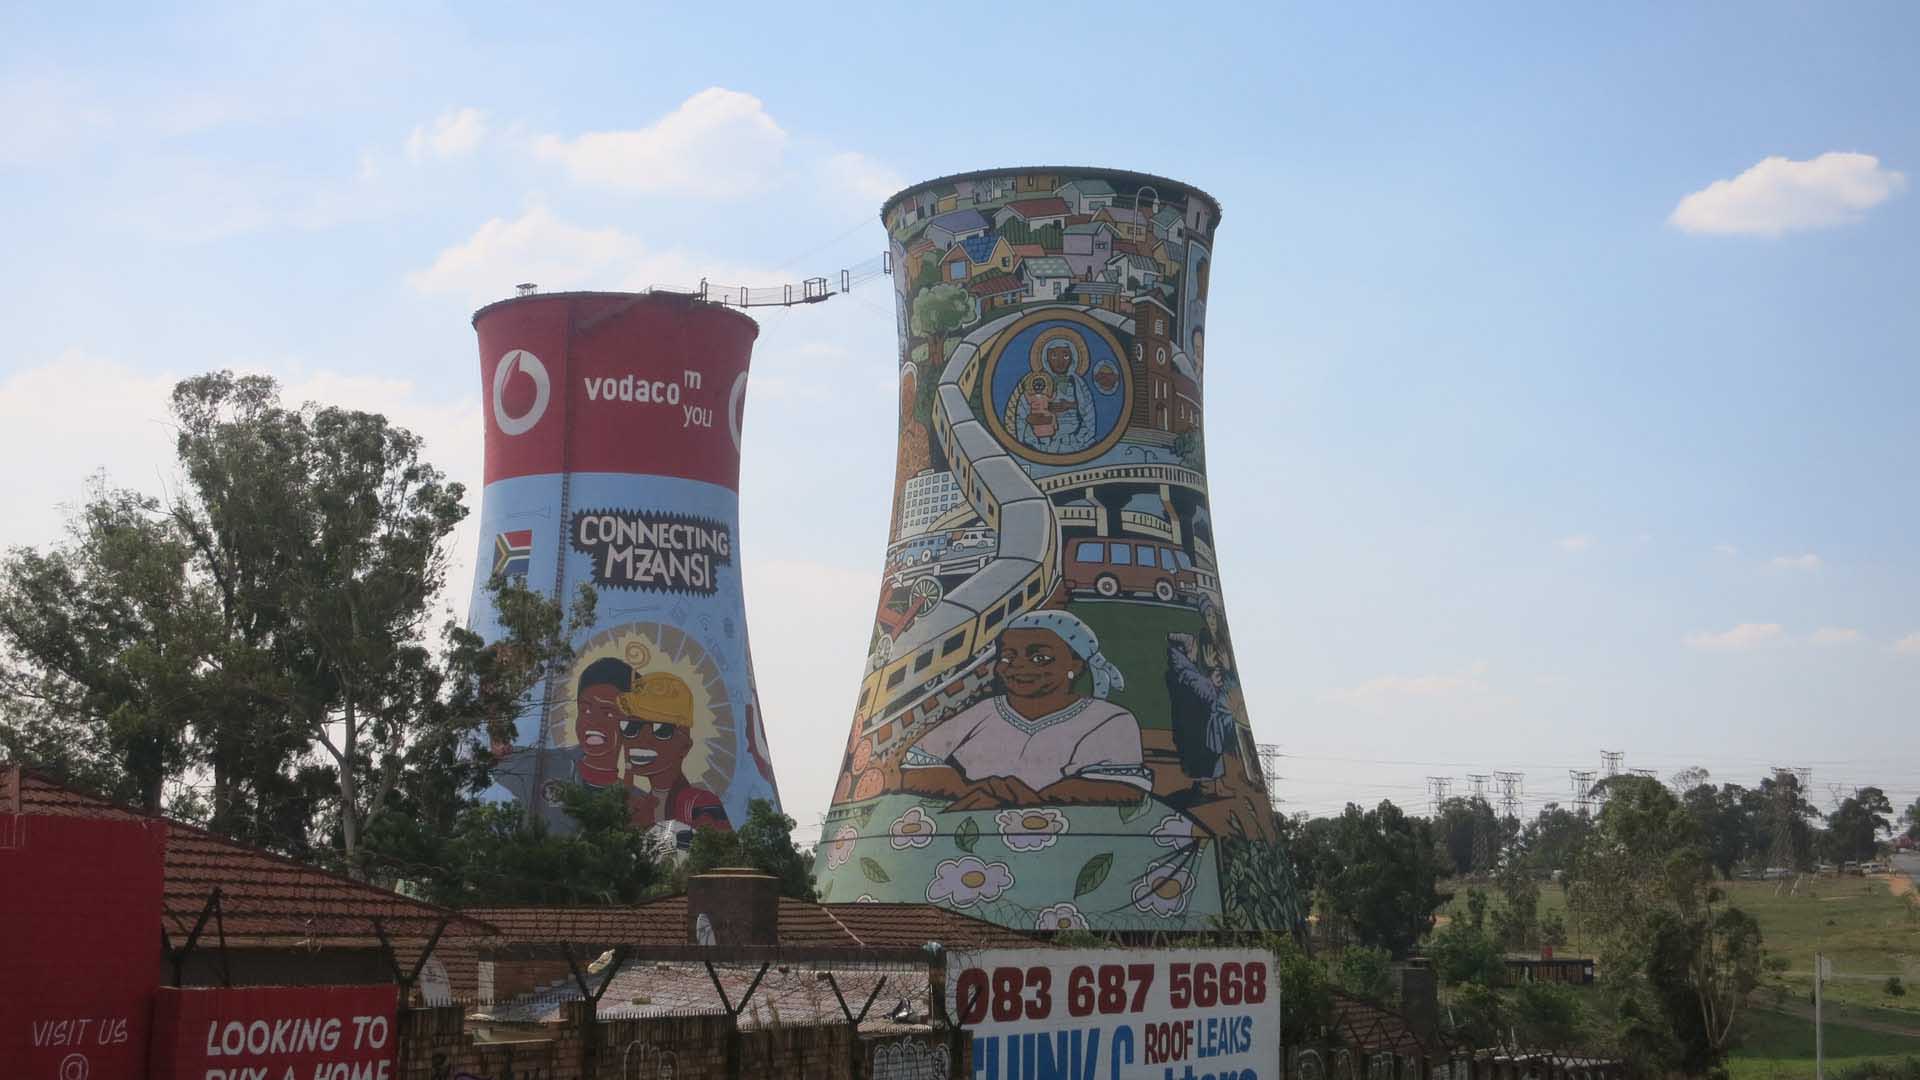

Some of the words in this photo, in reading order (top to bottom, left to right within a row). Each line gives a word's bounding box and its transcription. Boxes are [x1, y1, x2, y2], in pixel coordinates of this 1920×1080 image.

[683, 404, 713, 428] you
[579, 515, 730, 557] CONNECTING
[604, 544, 711, 589] MZANSI
[955, 966, 1053, 1026] 083
[1067, 963, 1155, 1018] 687
[1169, 961, 1267, 1010] 5668
[33, 1018, 95, 1047] VISIT
[98, 1017, 129, 1045] US
[206, 1017, 342, 1057] LOOKING
[352, 1015, 389, 1051] TO
[1144, 1020, 1194, 1065] ROOF
[1197, 1015, 1253, 1058] LEAKS
